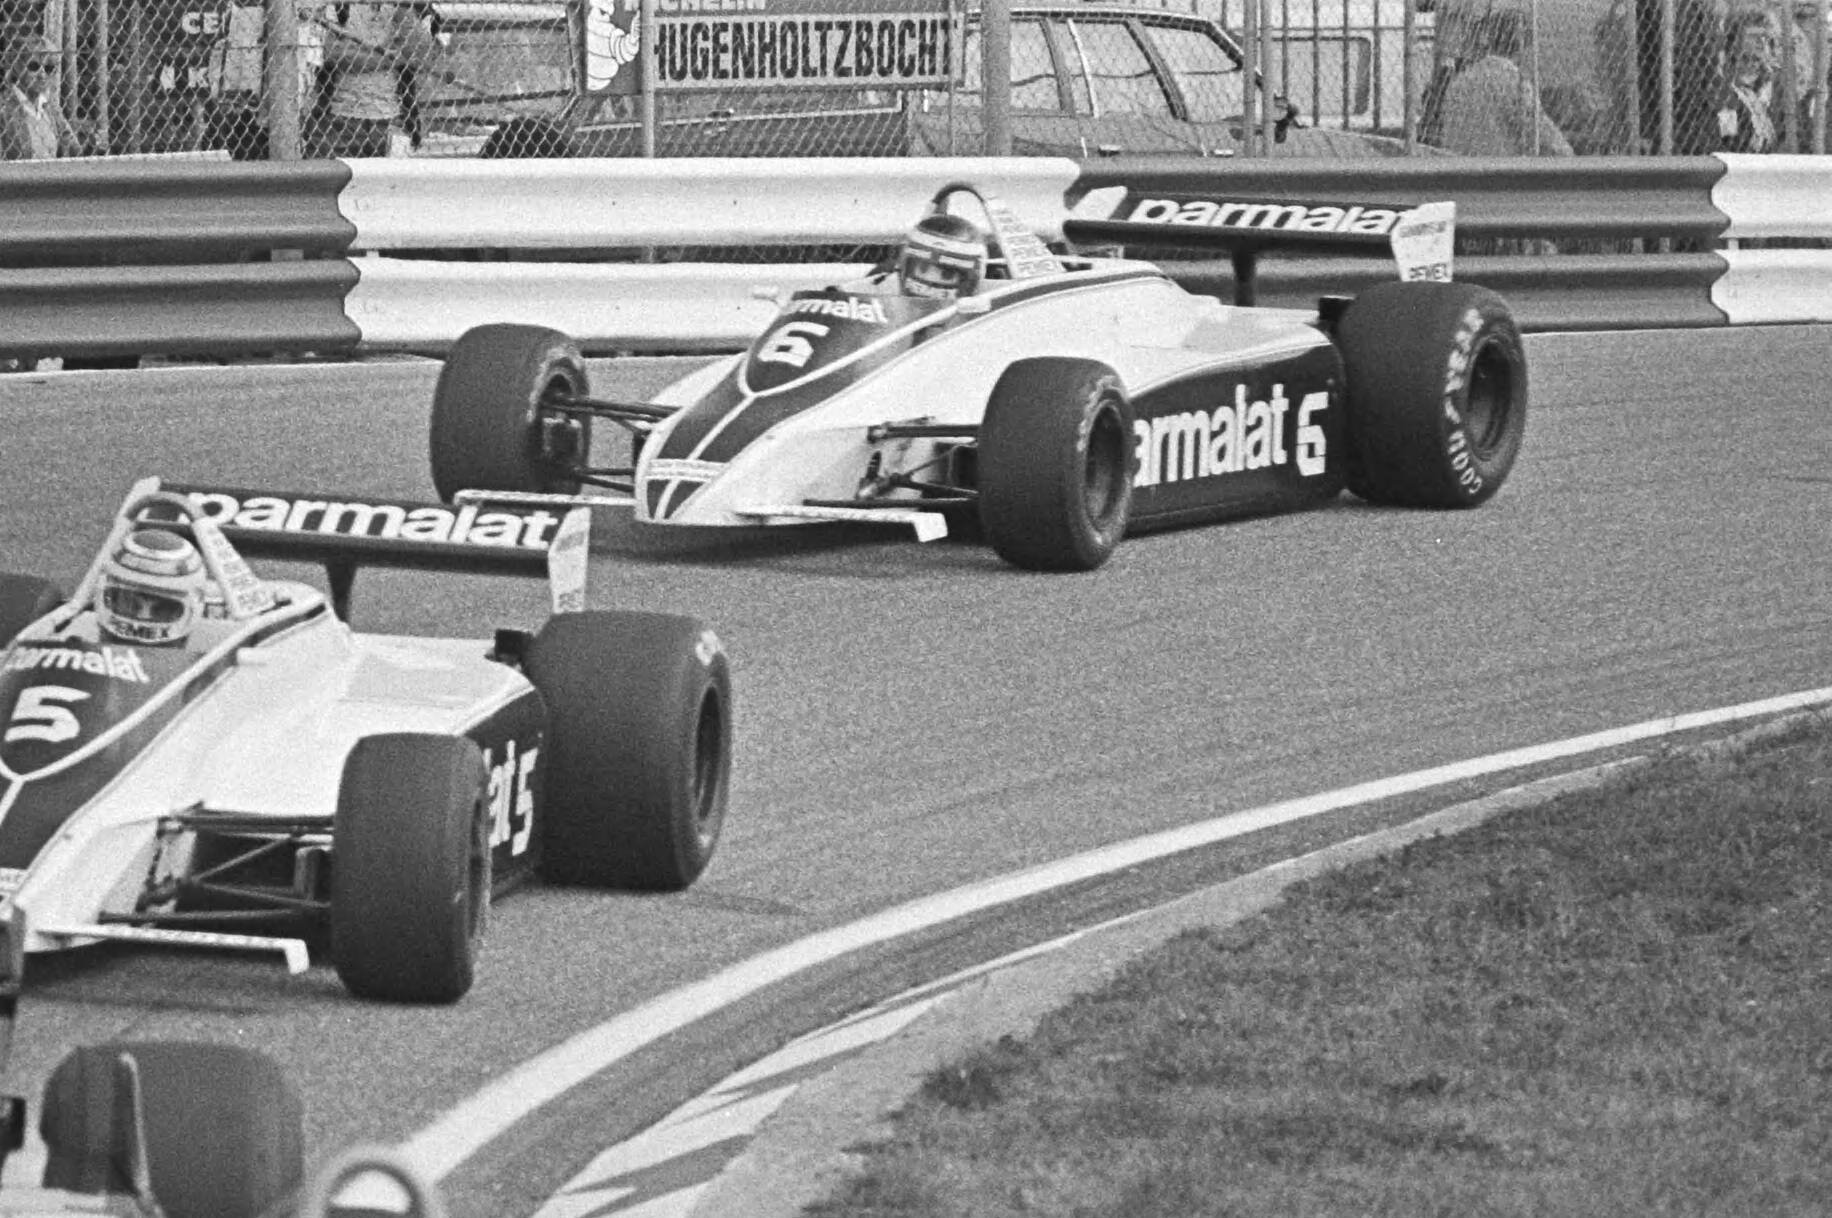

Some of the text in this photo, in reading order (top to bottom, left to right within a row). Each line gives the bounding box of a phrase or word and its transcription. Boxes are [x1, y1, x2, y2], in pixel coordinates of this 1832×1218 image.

[757, 321, 830, 367] 6
[1133, 384, 1329, 488] armalat 6
[180, 492, 559, 548] parmalat
[4, 685, 92, 743] 5
[511, 746, 539, 857] 5
